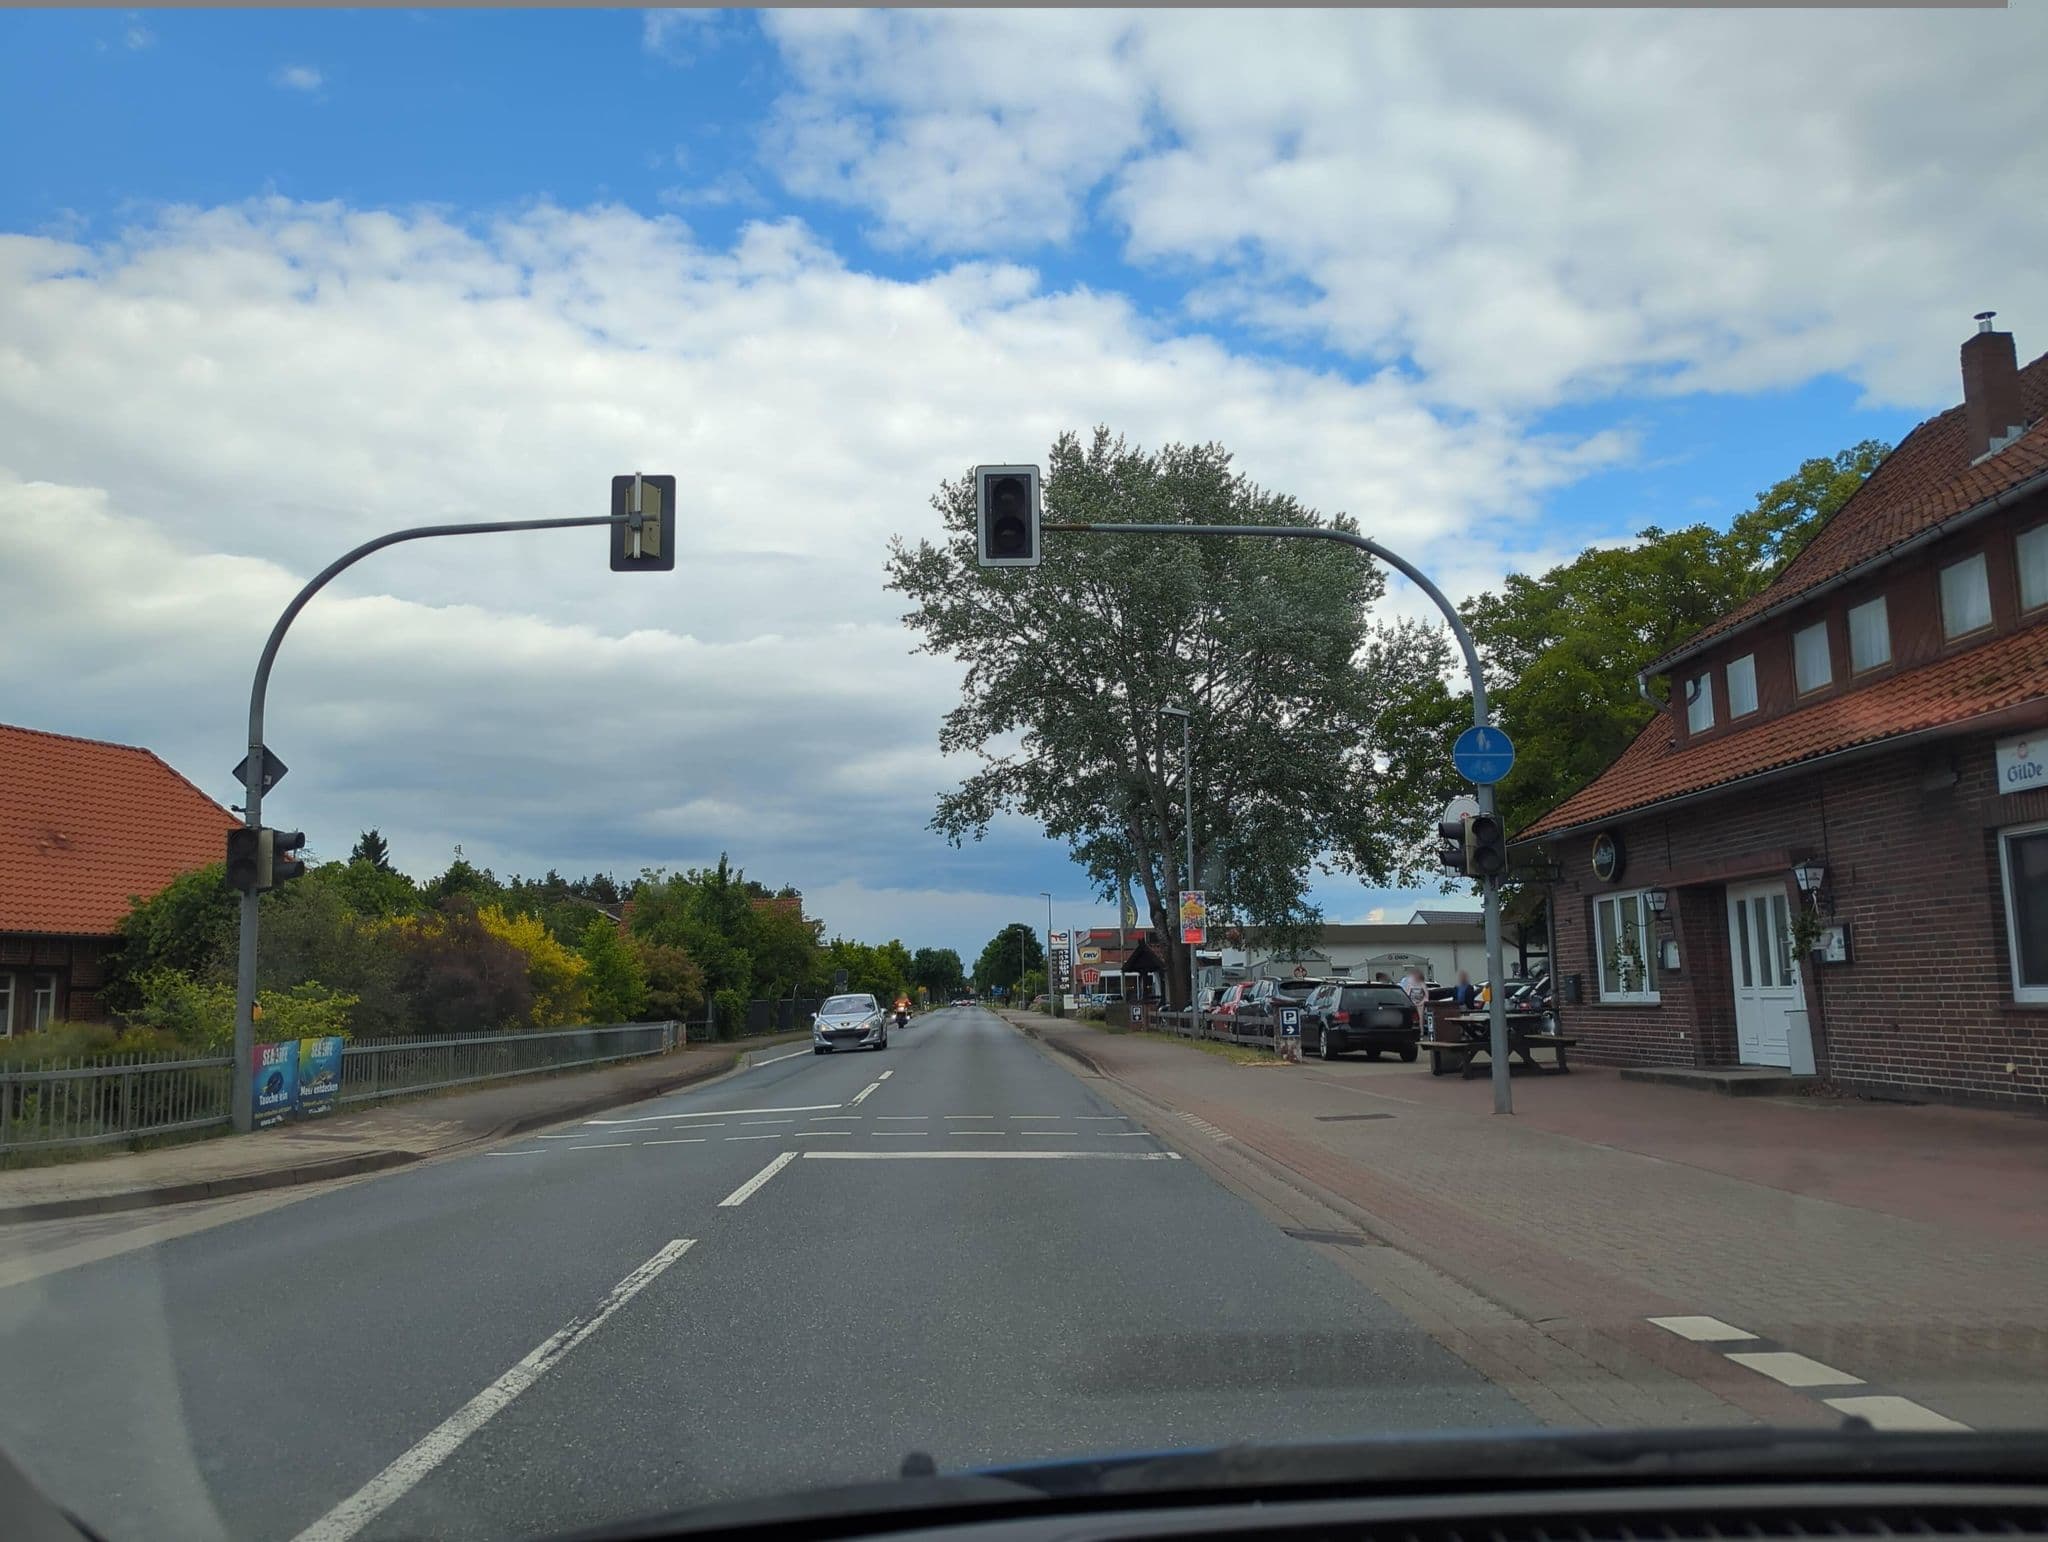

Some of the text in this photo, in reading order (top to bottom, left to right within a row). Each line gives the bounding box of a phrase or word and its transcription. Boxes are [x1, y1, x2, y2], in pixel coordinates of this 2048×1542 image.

[2007, 762, 2043, 783] Gilde
[1083, 970, 1099, 983] UTA
[1286, 1012, 1294, 1020] P
[262, 1048, 275, 1066] SEA
